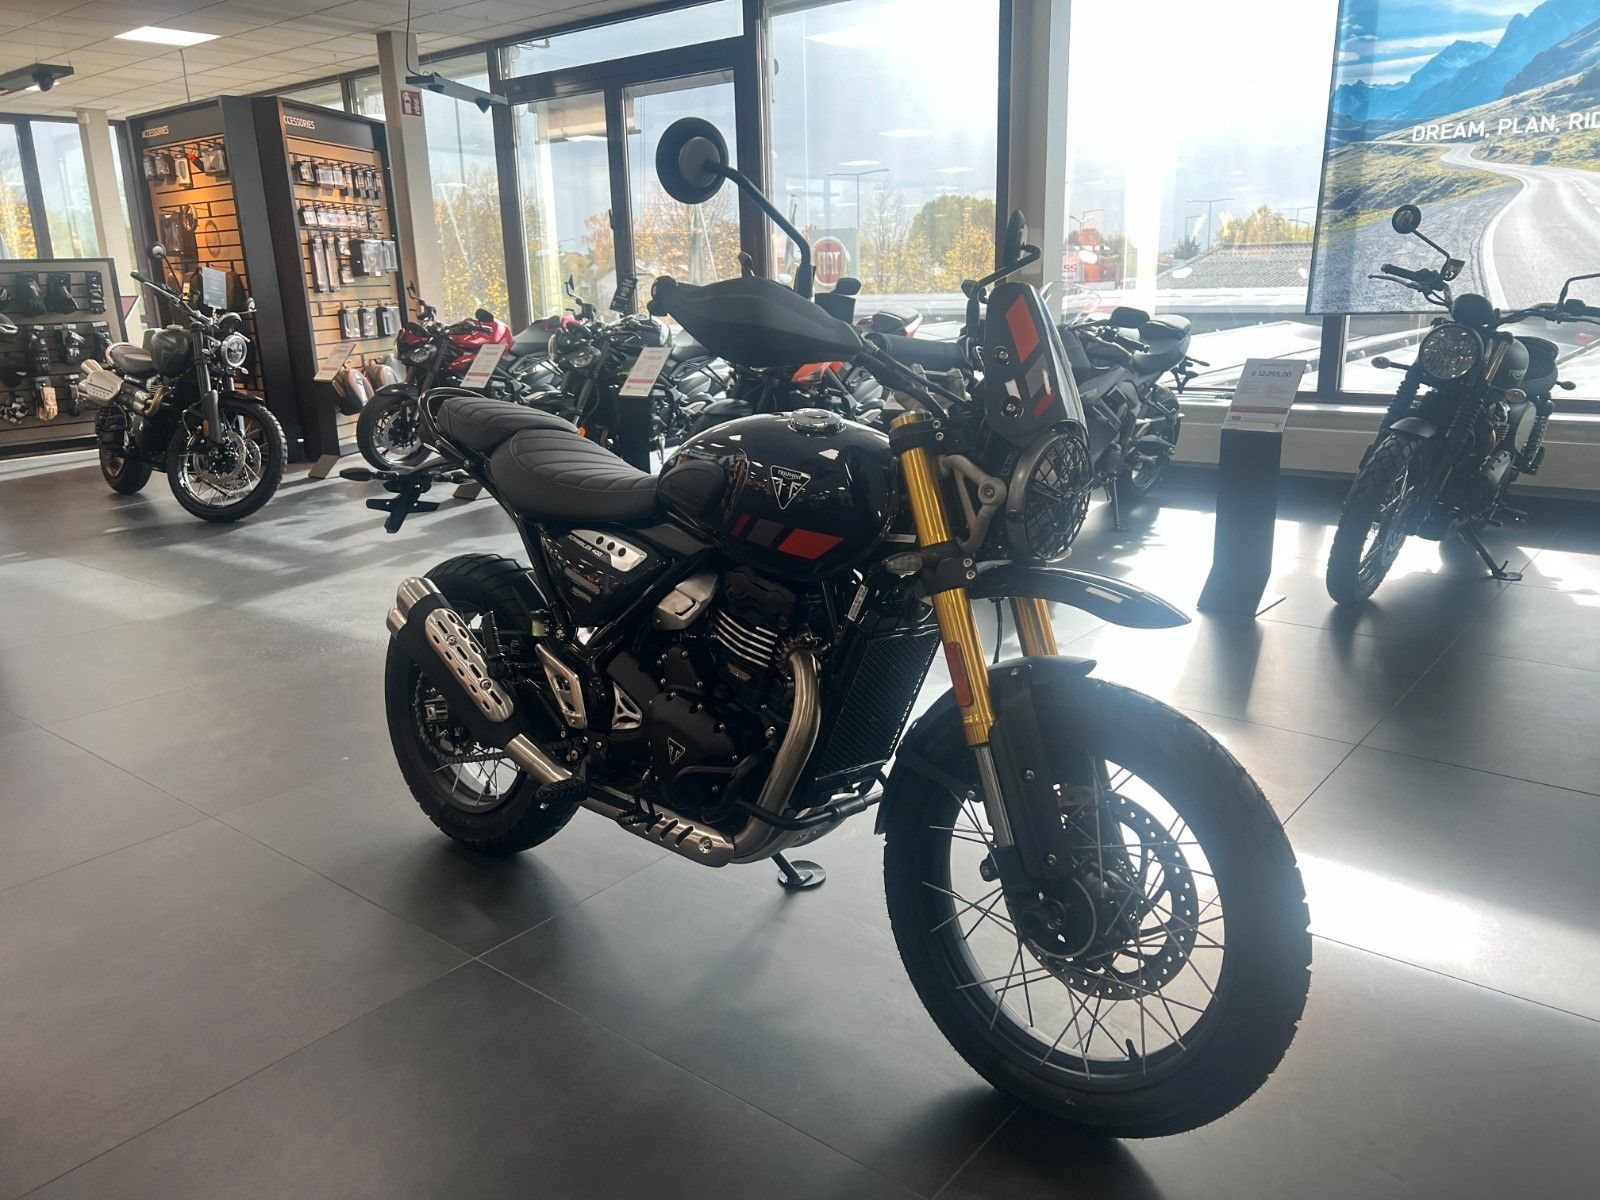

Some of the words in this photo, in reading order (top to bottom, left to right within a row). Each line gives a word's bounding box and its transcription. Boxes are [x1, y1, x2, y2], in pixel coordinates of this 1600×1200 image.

[283, 115, 315, 129] CCESSORIES
[1412, 120, 1490, 142] DREAM,
[1498, 114, 1560, 135] PLAN,
[1568, 112, 1600, 130] RID
[817, 251, 841, 275] FIAT
[777, 469, 801, 480] TRIUMPH
